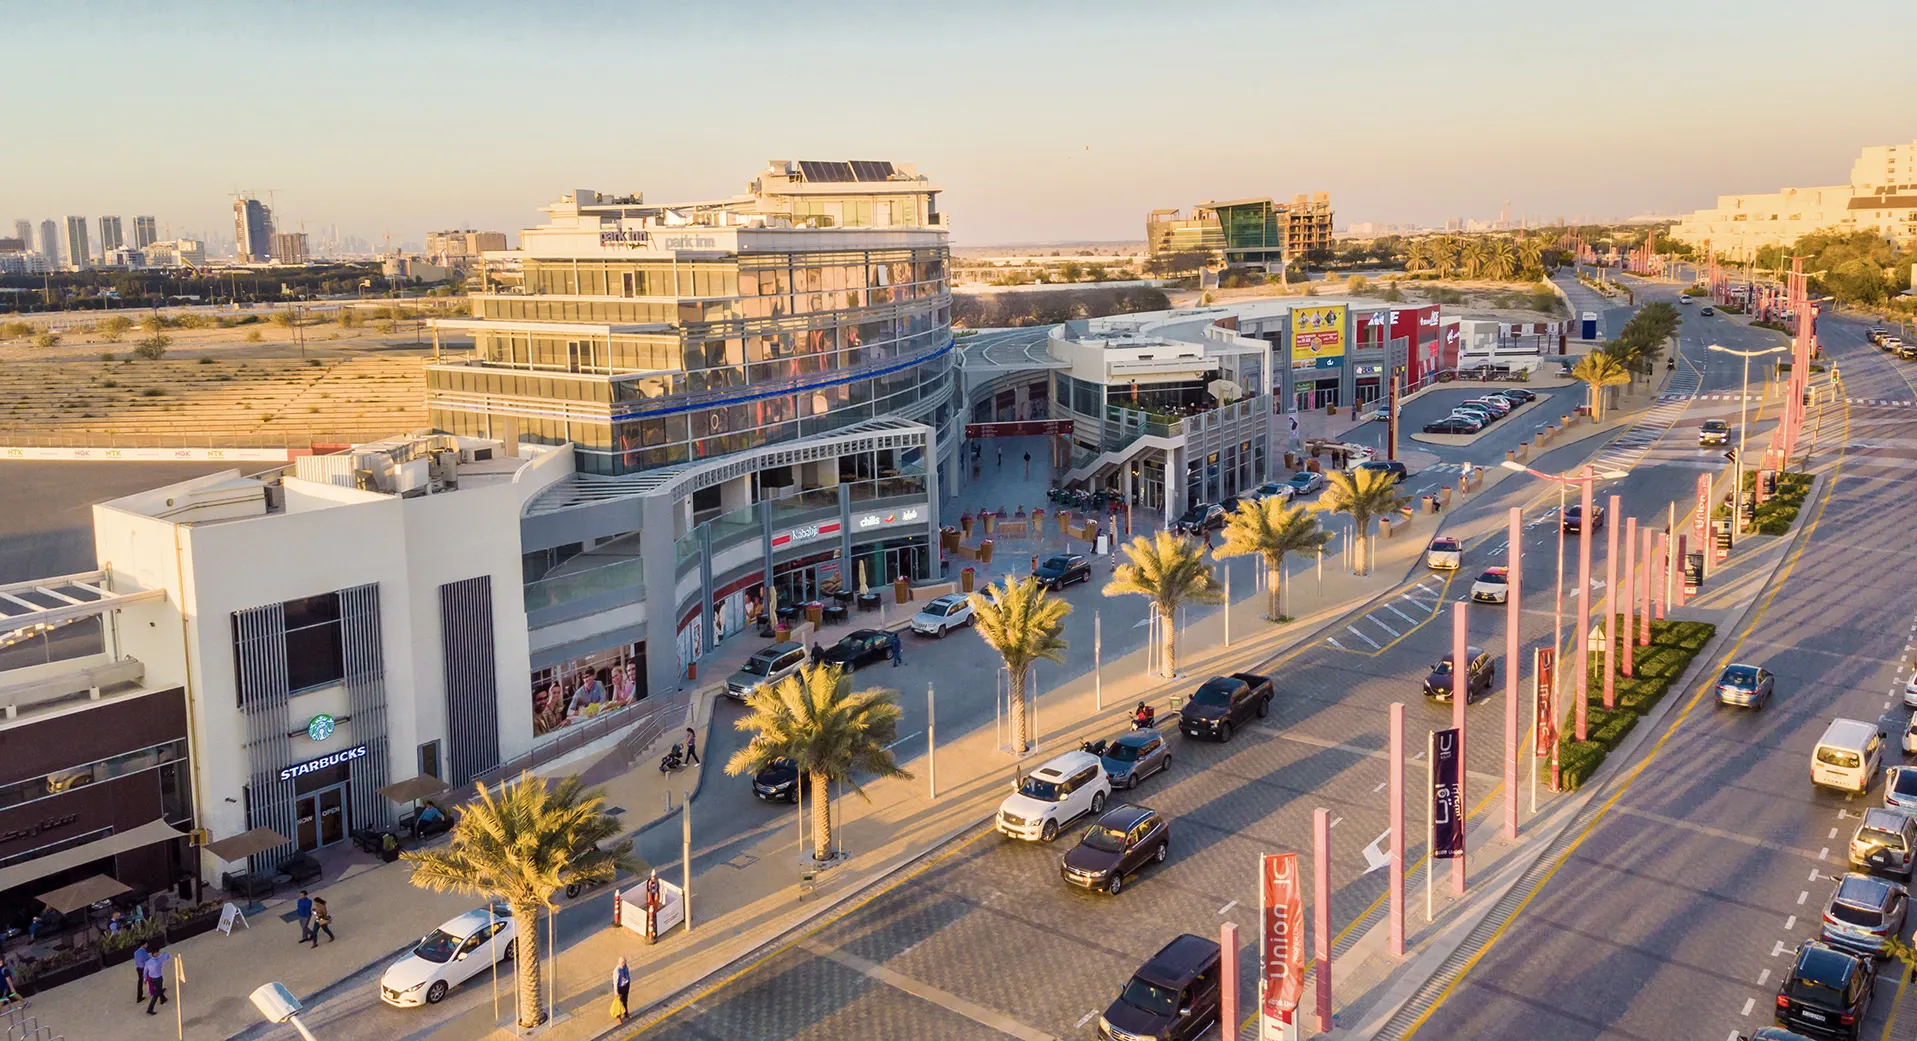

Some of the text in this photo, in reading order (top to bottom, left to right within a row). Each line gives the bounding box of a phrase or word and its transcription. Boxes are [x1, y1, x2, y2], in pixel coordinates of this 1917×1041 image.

[600, 227, 648, 245] park inn
[281, 746, 366, 781] STARBUCKS
[1270, 903, 1289, 978] Union
